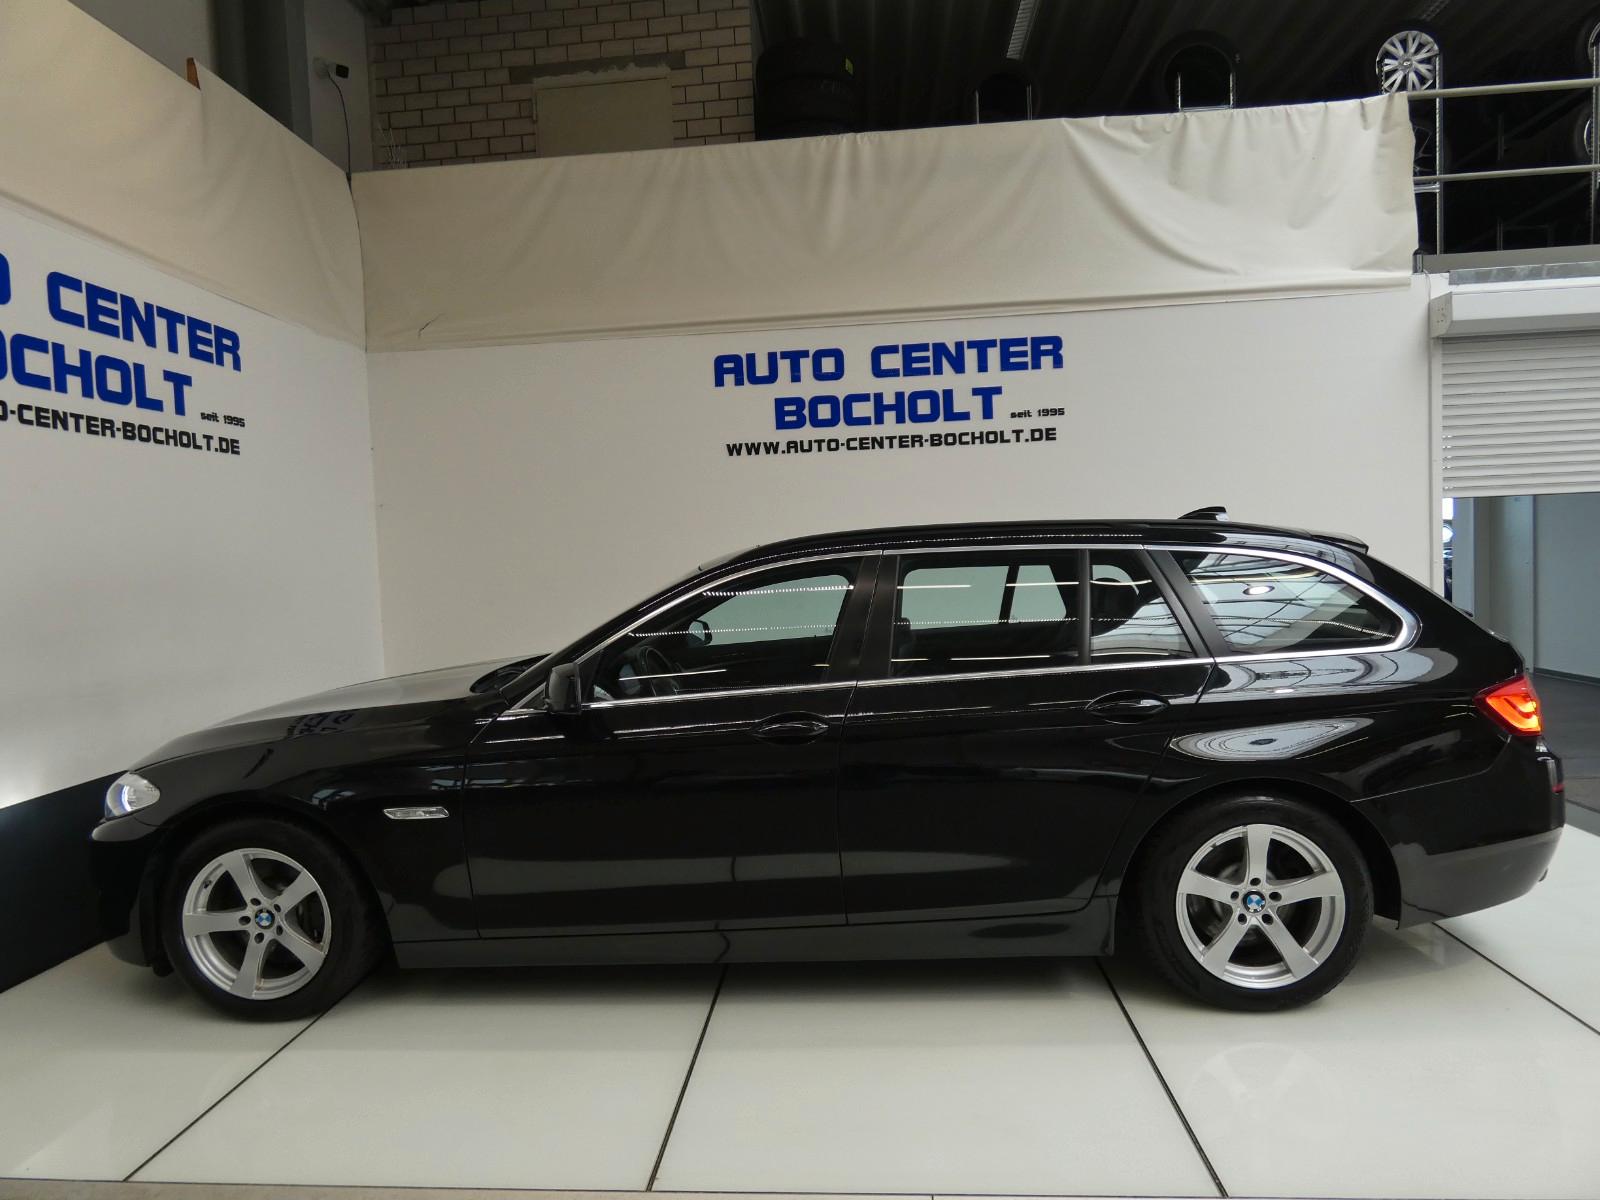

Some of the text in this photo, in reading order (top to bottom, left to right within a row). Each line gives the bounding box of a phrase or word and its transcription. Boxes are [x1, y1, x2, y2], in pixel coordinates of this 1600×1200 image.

[46, 271, 242, 373] CENTER
[0, 329, 193, 417] CHOLT
[713, 335, 1064, 388] AUTO CENTER
[199, 411, 246, 428] seit 1995
[773, 385, 1066, 431] BOCHOLT seit 1995
[725, 427, 1057, 457] WWW.AUTO-CENTER-BOCHOLT.DE
